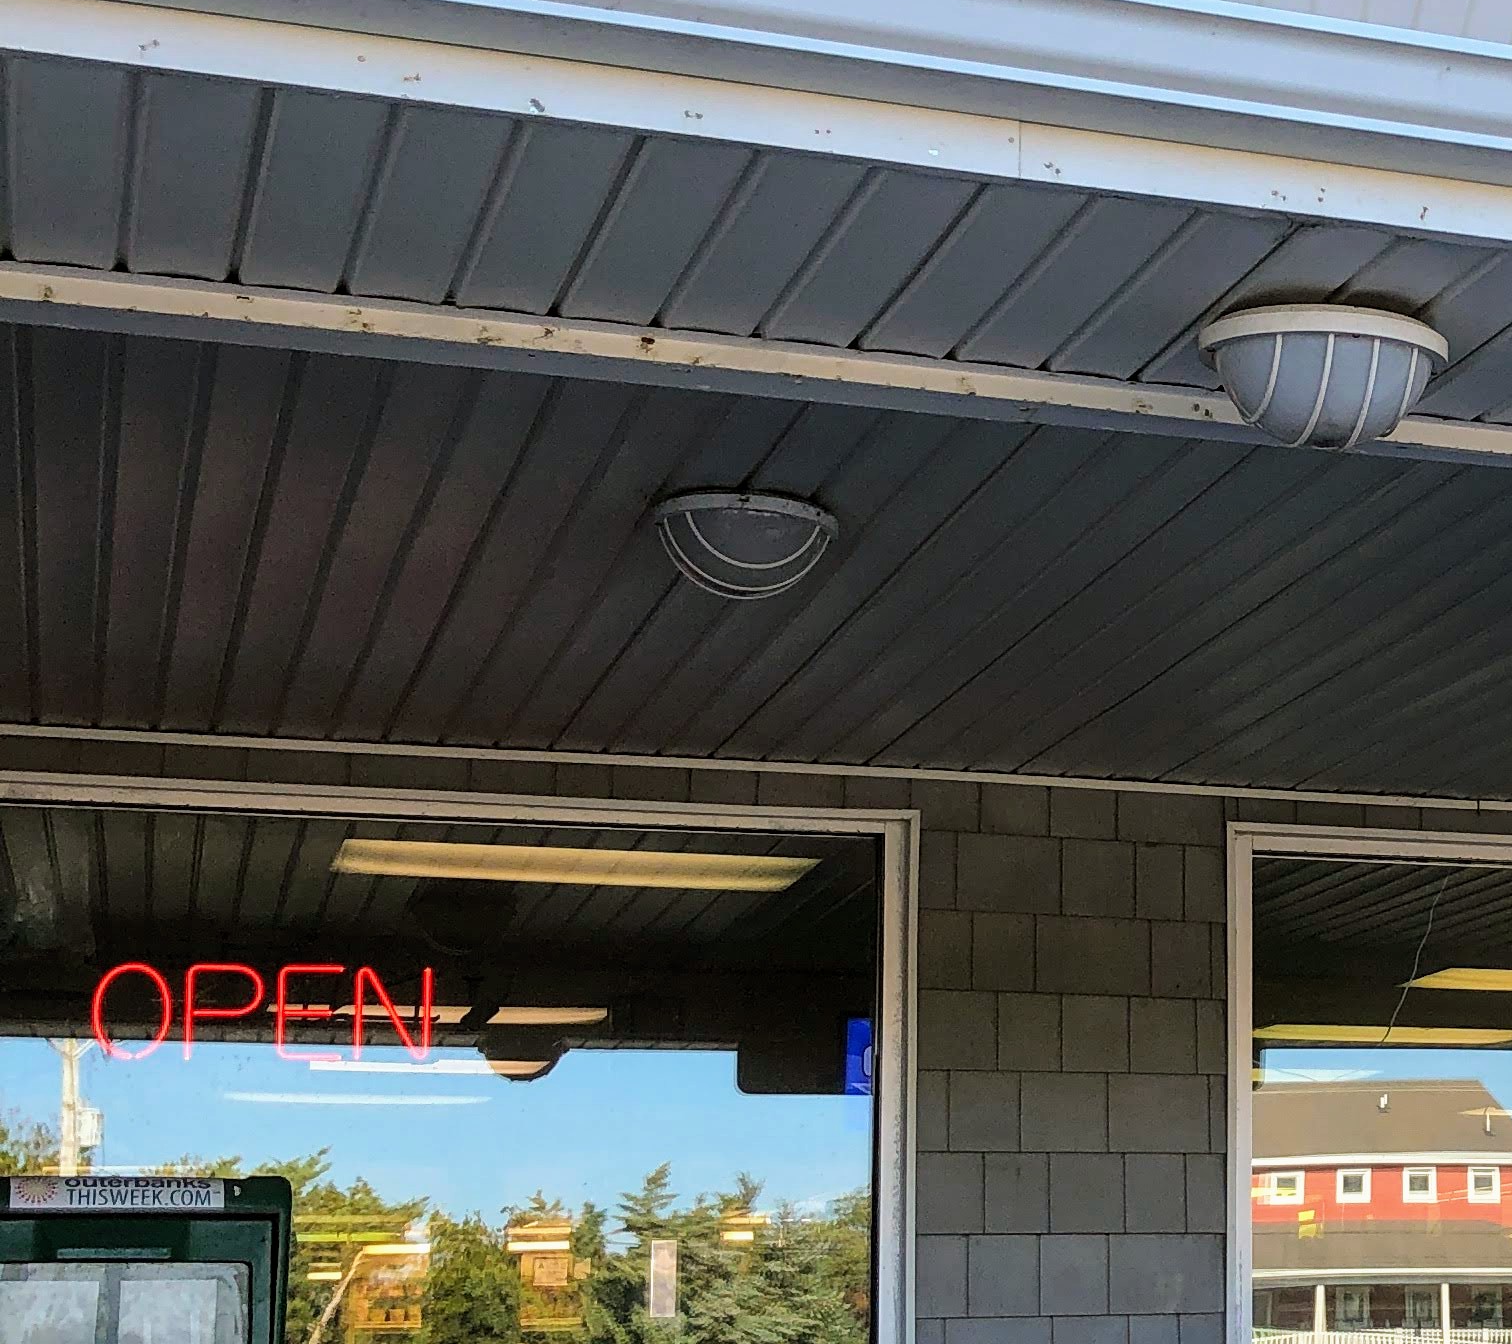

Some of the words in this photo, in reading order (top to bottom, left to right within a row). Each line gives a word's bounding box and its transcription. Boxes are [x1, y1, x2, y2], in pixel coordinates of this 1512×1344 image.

[90, 962, 436, 1061] OPEN
[64, 1178, 212, 1189] outerbanks
[66, 1189, 212, 1207] THISWEEK.COM
